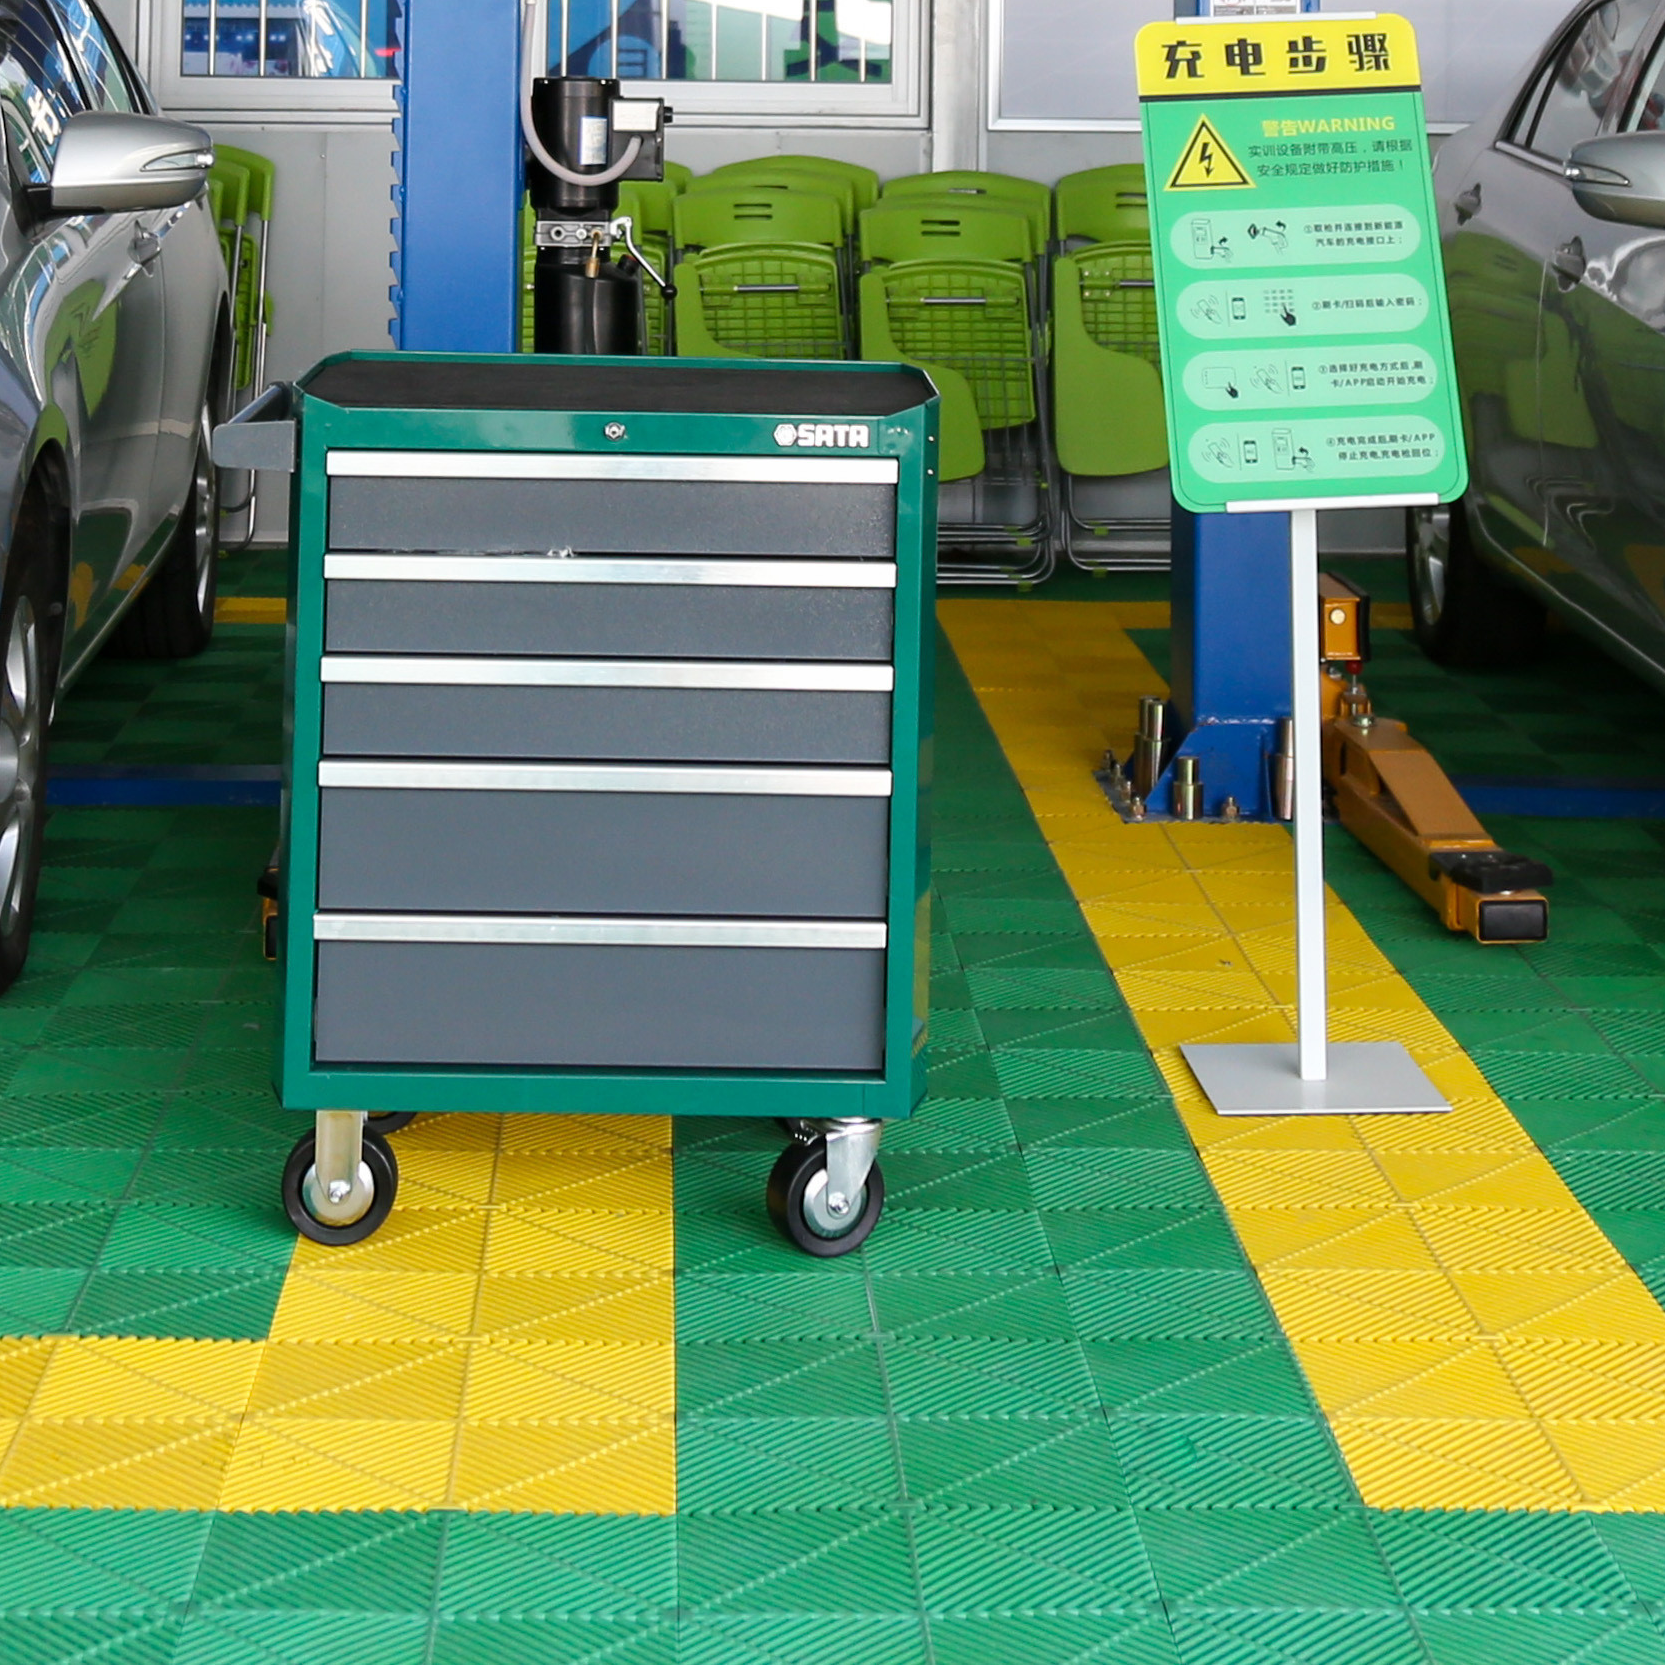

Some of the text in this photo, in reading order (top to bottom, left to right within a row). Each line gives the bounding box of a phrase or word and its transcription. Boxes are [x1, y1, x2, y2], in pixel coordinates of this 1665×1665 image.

[1161, 32, 1392, 80] 充电步骤
[797, 423, 870, 448] SATA
